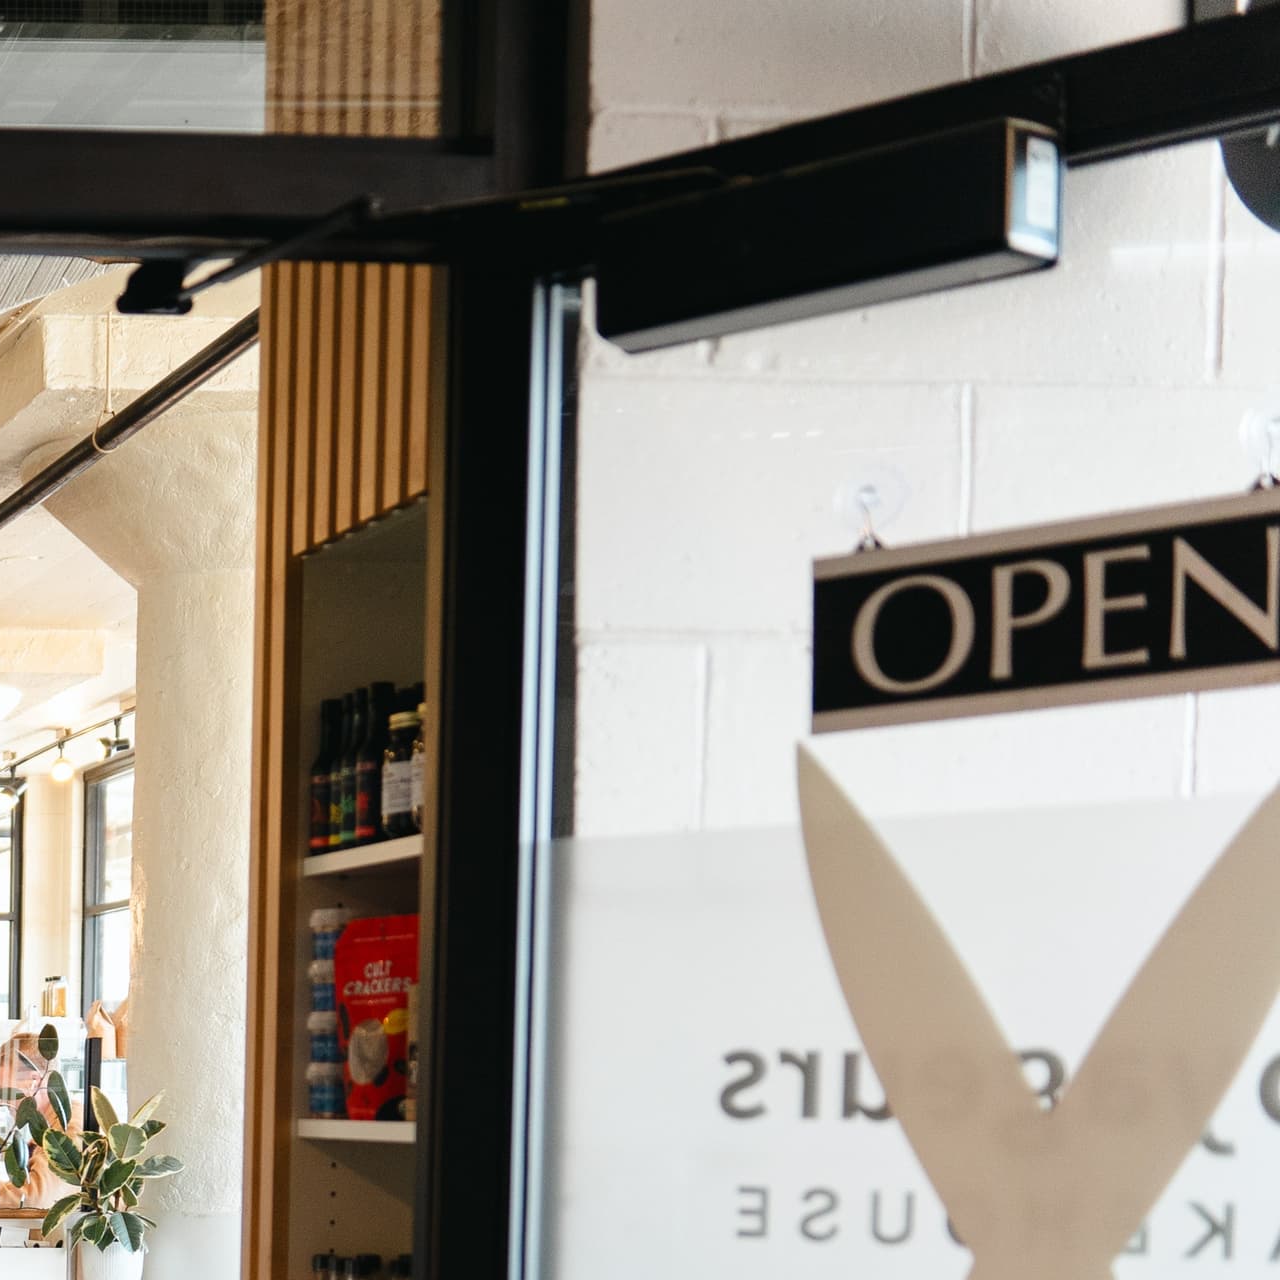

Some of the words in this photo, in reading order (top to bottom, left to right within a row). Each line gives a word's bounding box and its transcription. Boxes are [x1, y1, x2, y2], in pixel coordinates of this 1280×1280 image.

[851, 526, 1280, 695] OPEN
[364, 961, 393, 978] CULT
[344, 977, 413, 996] CRACKERS
